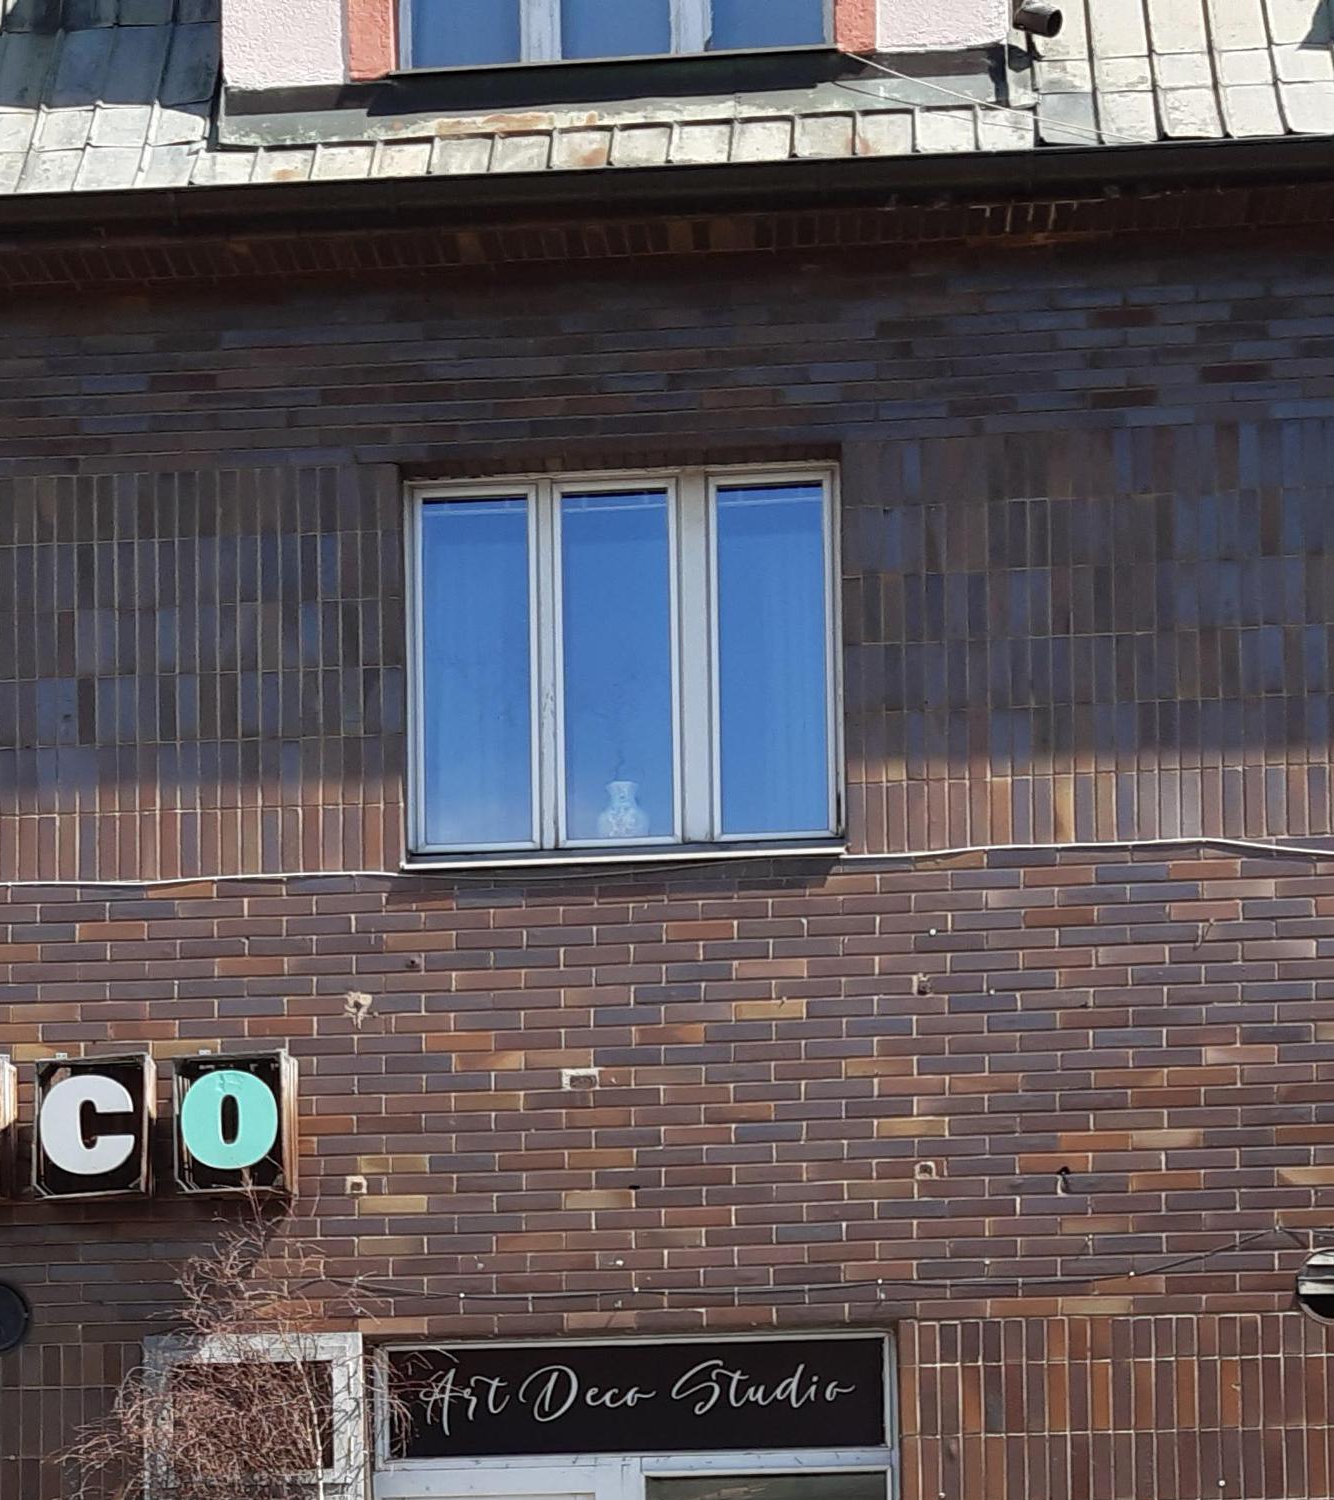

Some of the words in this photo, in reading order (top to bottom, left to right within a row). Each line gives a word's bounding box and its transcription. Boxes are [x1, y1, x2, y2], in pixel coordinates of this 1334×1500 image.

[419, 1367, 510, 1436] Art
[519, 1365, 657, 1422] Deco
[671, 1359, 856, 1415] Studio
